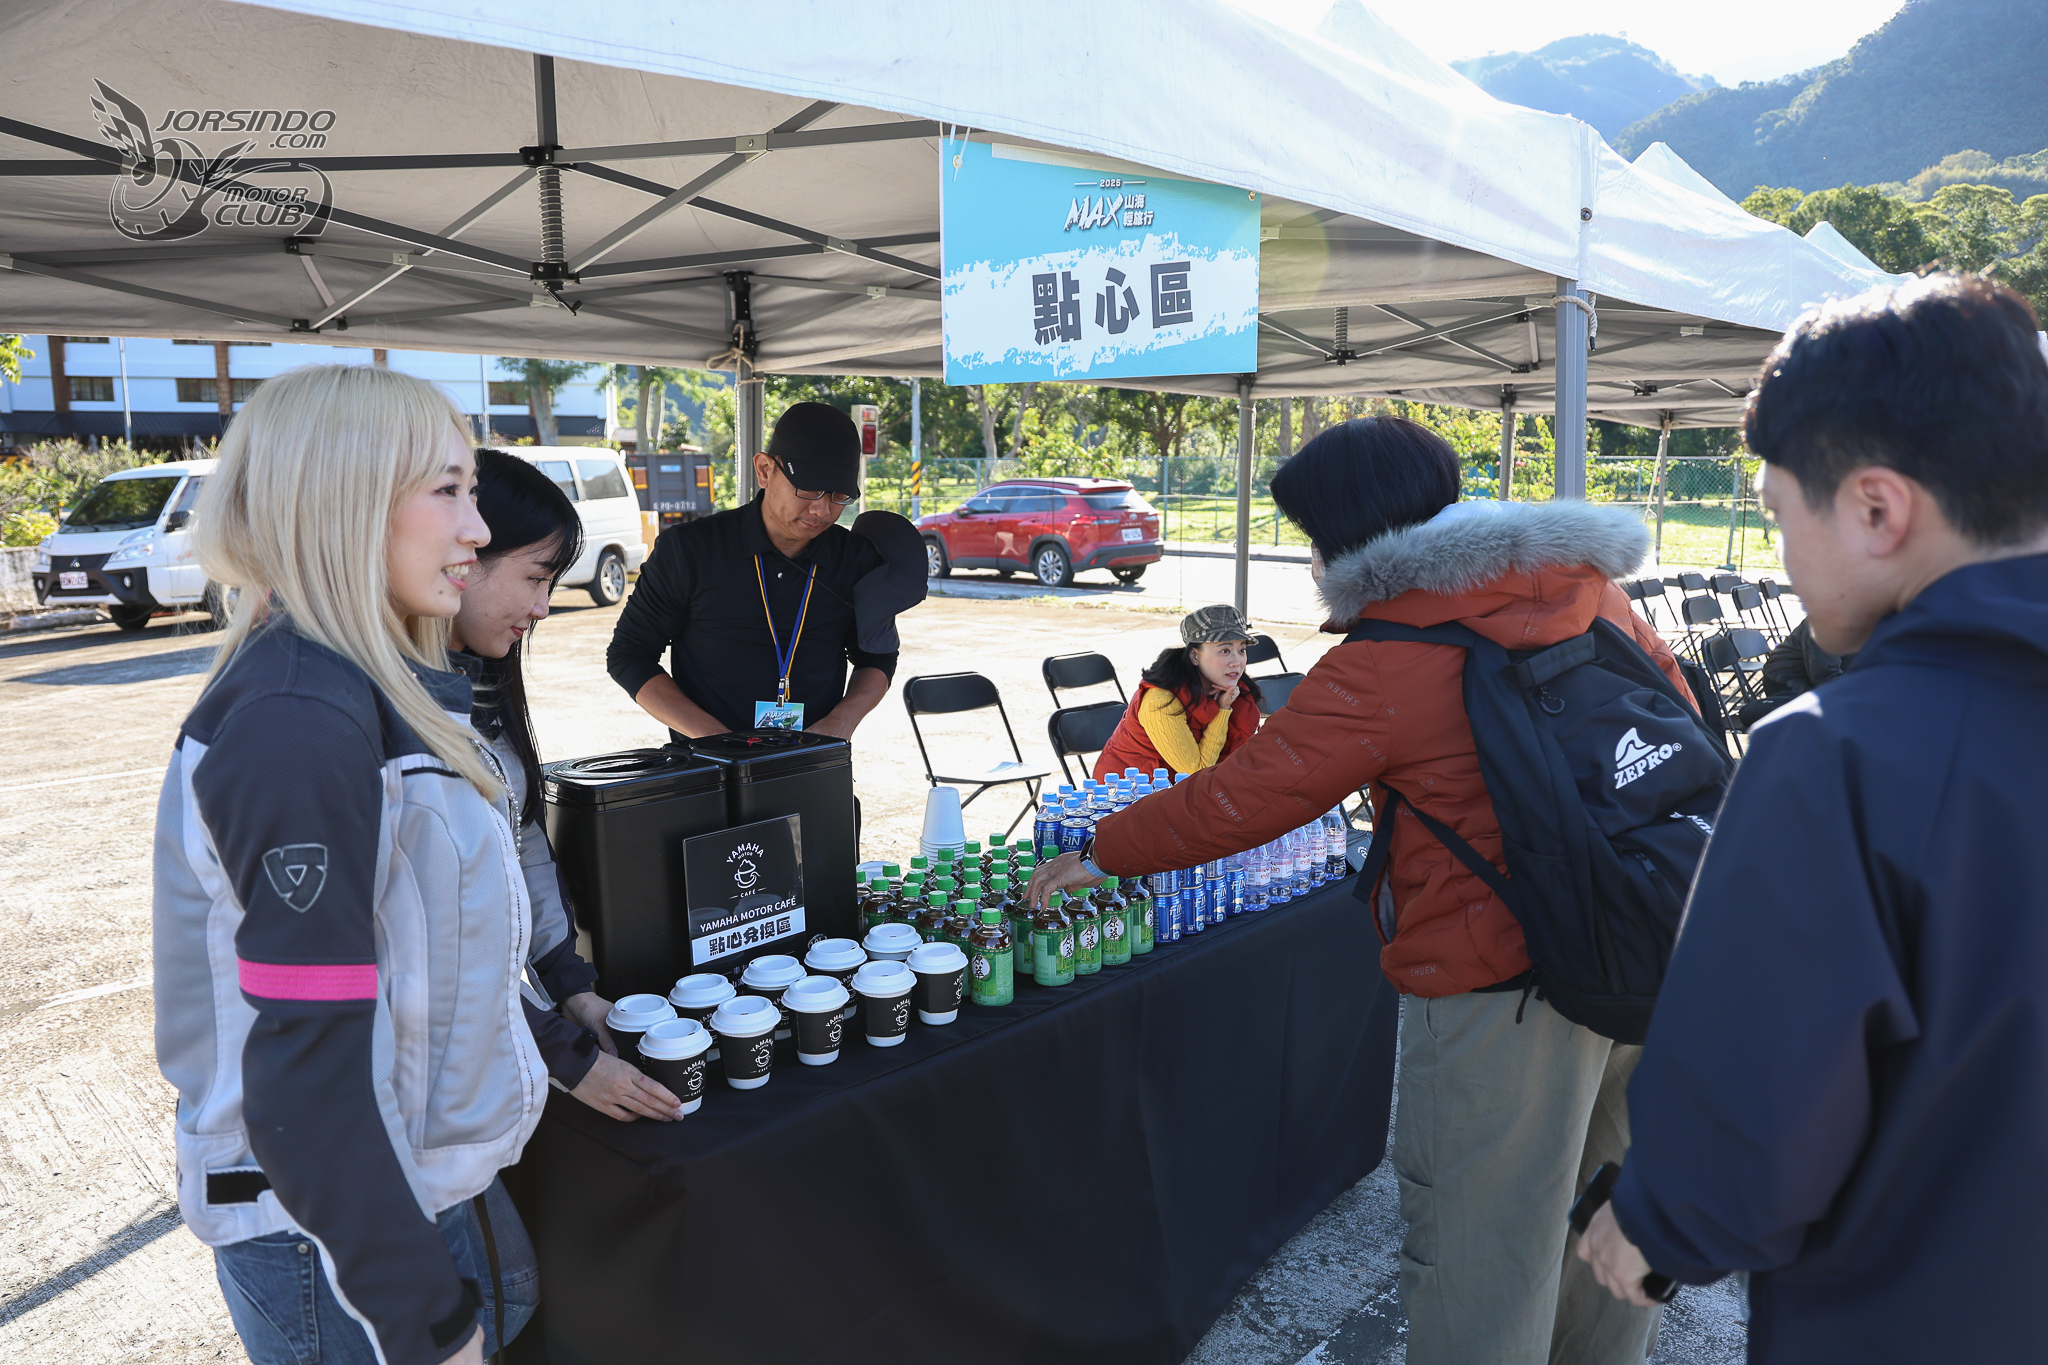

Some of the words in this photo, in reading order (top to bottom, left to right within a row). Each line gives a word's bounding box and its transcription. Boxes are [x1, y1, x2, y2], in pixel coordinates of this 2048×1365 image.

[1099, 179, 1122, 188] 2025
[1063, 193, 1124, 231] MAX
[1124, 194, 1146, 209] 山海
[1032, 260, 1193, 346] 點心區
[1326, 681, 1361, 707] SHUEN
[1275, 737, 1303, 766] SHUEN
[726, 842, 764, 864] YAMAHA
[1062, 836, 1081, 846] FIN
[700, 914, 739, 933] YAMAHA
[740, 905, 773, 920] MOTOR
[775, 895, 797, 911] CAFÉ
[1410, 965, 1437, 977] SHUEN
